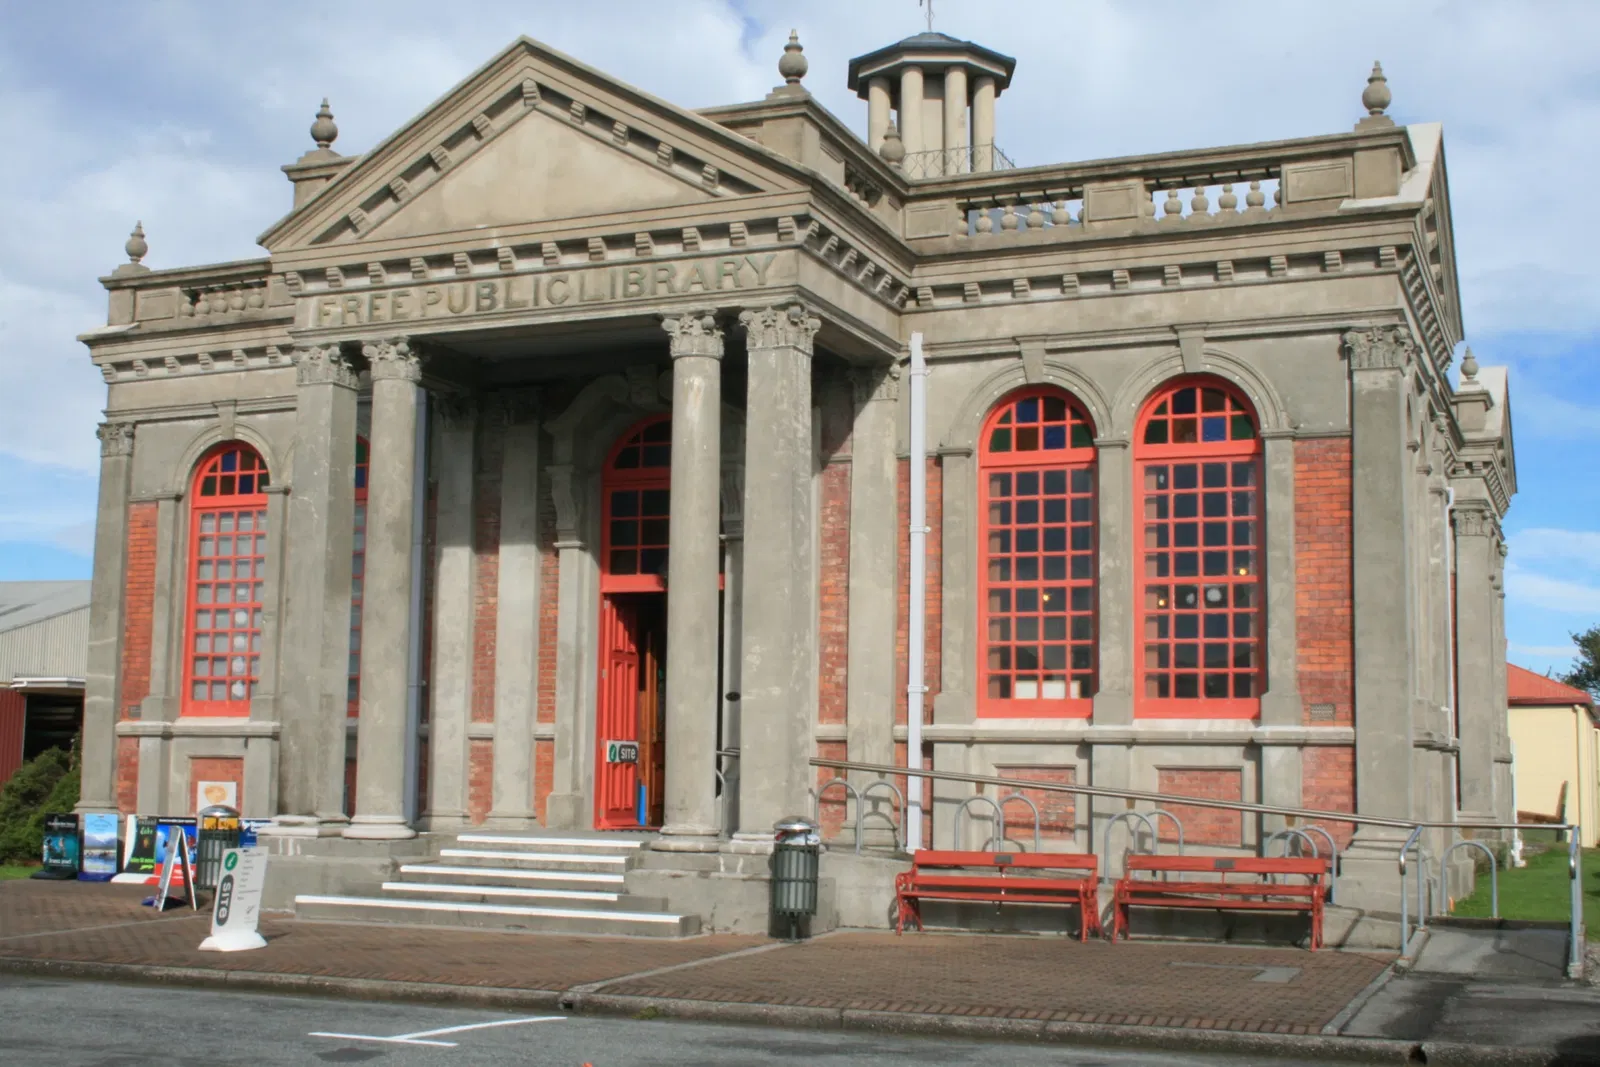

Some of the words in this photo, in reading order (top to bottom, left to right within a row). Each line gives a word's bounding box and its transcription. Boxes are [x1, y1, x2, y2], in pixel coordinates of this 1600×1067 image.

[317, 289, 412, 327] FREE
[420, 274, 570, 317] PUBLIC
[579, 254, 776, 302] LIBRARY
